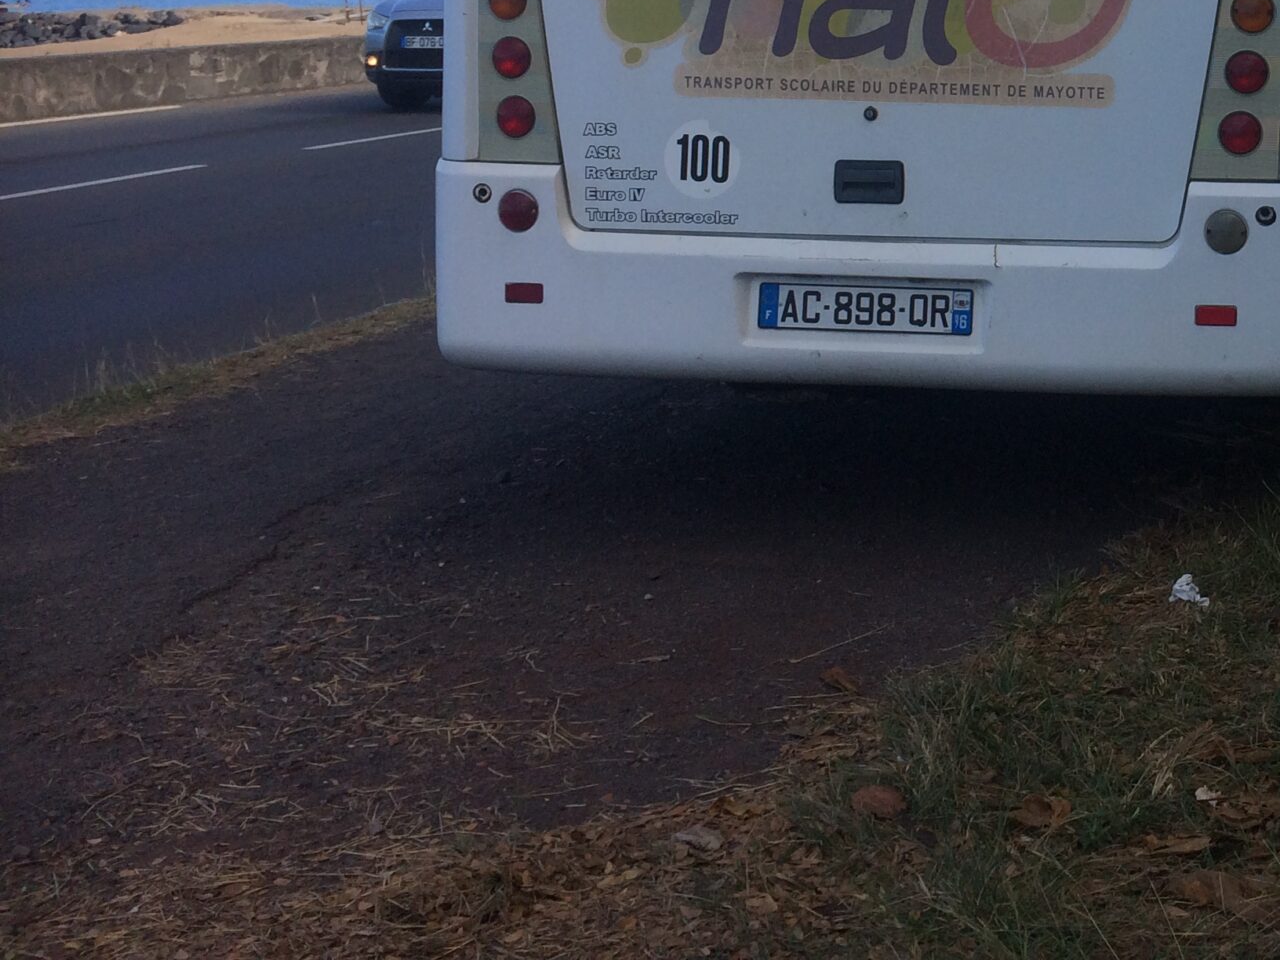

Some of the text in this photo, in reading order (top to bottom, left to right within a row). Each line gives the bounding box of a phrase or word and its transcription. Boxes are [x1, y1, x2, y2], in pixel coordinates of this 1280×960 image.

[684, 75, 1105, 100] TRANSPORT SCOLAIRE DU DÉPARTEMENT DE MAYOTTE
[583, 122, 617, 136] ABS
[585, 145, 621, 159] ASR
[677, 134, 730, 184] 100
[585, 166, 657, 180] Retarder
[585, 187, 645, 201] Euro IV
[585, 208, 739, 224] Turbo Intercooler
